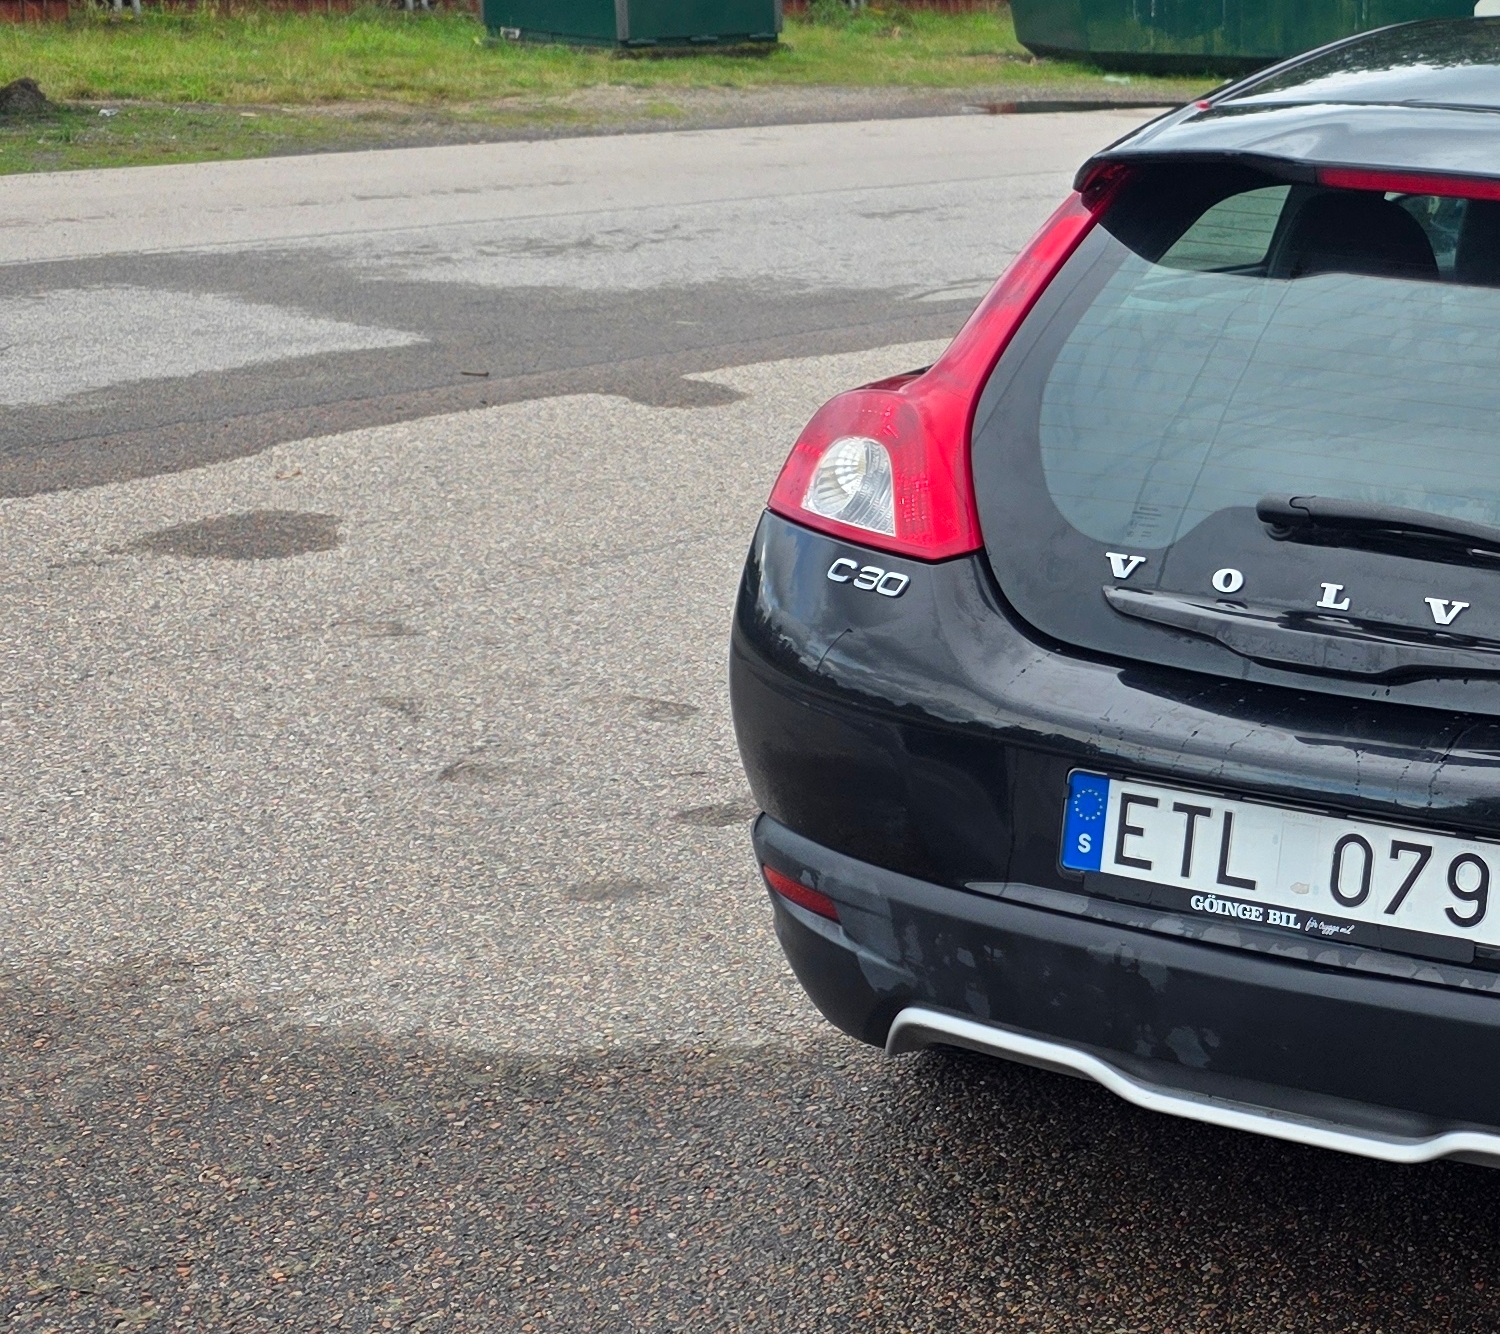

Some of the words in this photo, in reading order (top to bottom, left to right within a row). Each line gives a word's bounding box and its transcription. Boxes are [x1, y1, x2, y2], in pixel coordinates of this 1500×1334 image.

[827, 557, 910, 597] C30
[1077, 833, 1092, 854] S
[1114, 792, 1256, 890] ETL
[1329, 832, 1491, 928] 079
[1190, 894, 1263, 922] GÖINGE
[1266, 909, 1301, 929] BIL
